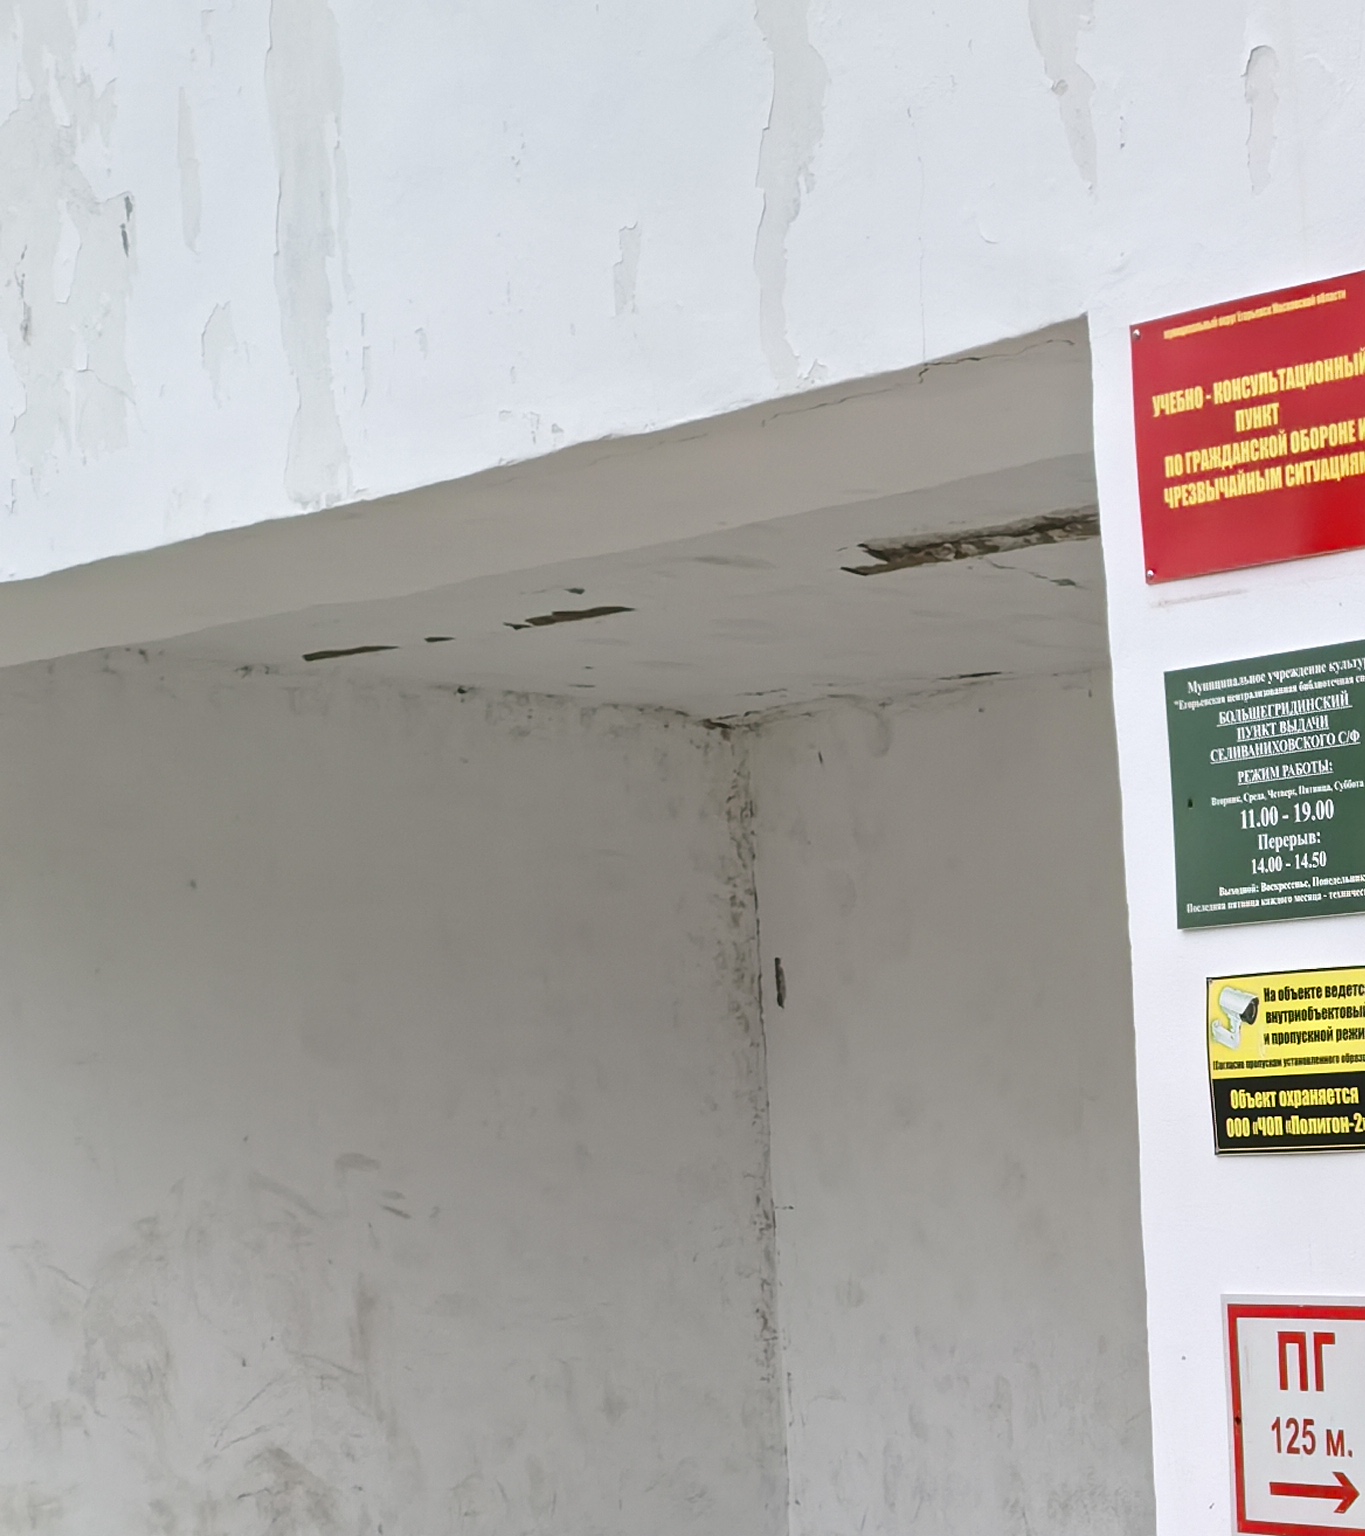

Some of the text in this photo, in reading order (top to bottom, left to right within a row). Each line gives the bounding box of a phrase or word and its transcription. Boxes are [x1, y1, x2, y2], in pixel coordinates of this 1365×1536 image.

[1152, 386, 1204, 417] УЧЕБНО
[1235, 402, 1280, 432] ПУНКТ
[1164, 454, 1183, 478] ПО
[1185, 429, 1288, 474] ГРАЖДАНСКОЙ
[1290, 420, 1357, 454] ОБОРОНЕ
[1163, 468, 1283, 509] ЧРЕЗВЫЧАЙНЫМ
[1187, 673, 1266, 696] Муниципальное
[1268, 663, 1326, 684] учреждение
[1218, 690, 1349, 726] БОЛЬШЕГРИДИНСКИЙ
[1237, 715, 1329, 741] ПУНКТ ВЫДАЧИ
[1210, 729, 1360, 763] СЕЛИВАНИХОВСКОГО С/Ф
[1238, 759, 1334, 784] РЕЖИМ РАБОТЫ:
[1241, 805, 1278, 829] 11.00
[1294, 798, 1334, 823] 19.00
[1258, 832, 1321, 852] Перерыв:
[1251, 856, 1283, 874] 14.00
[1294, 851, 1327, 870] 14.50
[1263, 987, 1276, 1003] На
[1278, 985, 1322, 1002] объекте
[1264, 1033, 1270, 1045] и
[1271, 1026, 1334, 1045] пропускной
[1230, 1086, 1359, 1109] Объект охраняется
[1226, 1117, 1250, 1137] ООО
[1277, 1331, 1336, 1392] ПГ
[1271, 1416, 1316, 1456] 125
